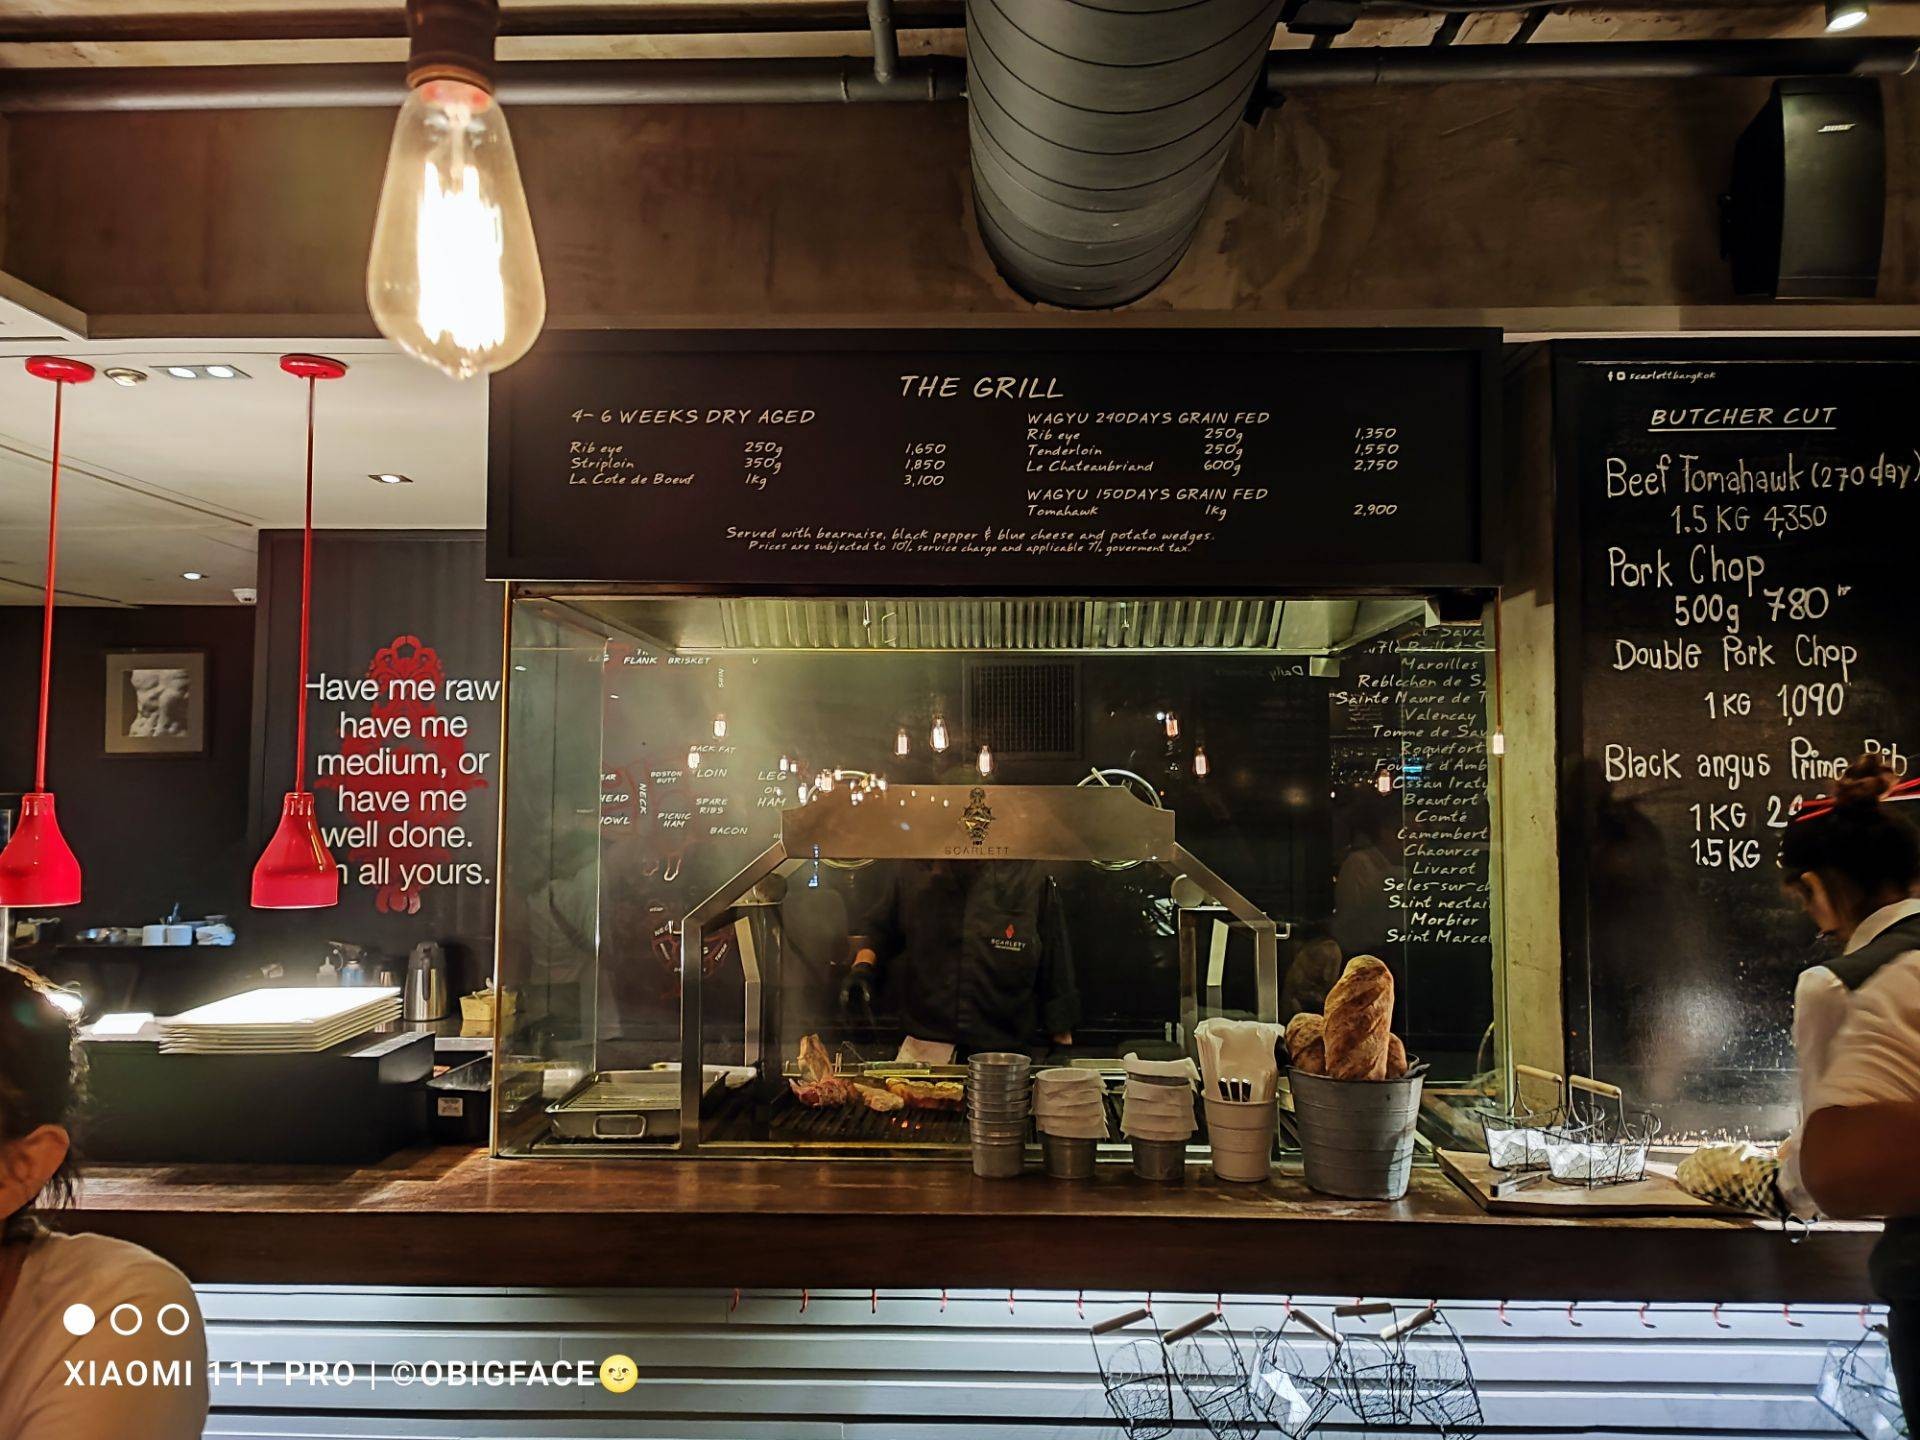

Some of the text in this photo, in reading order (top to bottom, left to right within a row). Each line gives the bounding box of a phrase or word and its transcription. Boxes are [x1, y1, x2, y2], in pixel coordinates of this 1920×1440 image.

[900, 375, 1064, 399] THE GRILL
[620, 408, 699, 424] WEEKS
[706, 408, 752, 424] DRY
[758, 408, 816, 424] AGED
[1027, 412, 1270, 425] WAGYU 240DAYS GRAIN FED
[1651, 407, 1838, 427] BUTCHER CUT
[1026, 427, 1397, 445] Rib eye 250g 1,350
[570, 441, 947, 459] Rib eye 250g 1,650
[1028, 443, 1400, 461] Tenderloin 250g 1,550
[570, 457, 946, 475] Striploin 350g 1,850
[1026, 459, 1399, 477] Le Chateaubriand 600g 2,750
[569, 473, 587, 485] La
[592, 472, 625, 485] Cote
[631, 473, 648, 485] de
[653, 472, 695, 485] Boeuf
[903, 474, 945, 487] 3,100
[1605, 453, 1672, 499] Beef
[1679, 452, 1805, 496] Tomahawk
[1027, 488, 1269, 501] WAGYU 150DAYS GRAIN FED
[1028, 504, 1099, 517] Tomahawk
[1353, 503, 1398, 516] 2,900
[1670, 503, 1828, 541] 1.5 KG 4,350
[725, 526, 1216, 546] Served with bearnaise, black pepper & blue cheese and potato wedges.
[749, 540, 786, 551] Prices
[790, 543, 810, 551] are
[815, 541, 869, 553] subjected
[873, 541, 886, 551] to
[917, 542, 957, 553] service
[961, 542, 998, 556] charge
[1001, 543, 1023, 552] and
[1026, 542, 1084, 555] applicable
[1607, 543, 1766, 598] Pork Chop
[1675, 585, 1830, 634] 500g 780
[623, 656, 713, 665] FLANK BRISKET
[1401, 657, 1478, 670] Maroilles
[1613, 633, 1858, 684] Double Pork Chop
[1442, 674, 1462, 687] de
[389, 678, 436, 701] me
[445, 678, 501, 701] raw
[1335, 690, 1471, 705] Sainte Maure de
[1776, 681, 1845, 727] 1,090
[1405, 707, 1477, 727] Valencay
[339, 711, 468, 739] have me
[1372, 724, 1450, 738] Tomme de
[1401, 741, 1486, 758] Roquefort
[317, 747, 490, 779] medium, or
[1604, 736, 1849, 791] Black angus Prime
[650, 770, 683, 778] BOSTON
[696, 768, 728, 779] LOIN
[757, 770, 787, 781] LEG
[338, 785, 467, 813] have me
[638, 782, 648, 816] NECK
[696, 797, 729, 806] SPARE
[757, 797, 787, 807] HAM
[1404, 792, 1479, 806] Beaufort
[657, 812, 692, 820] PICNIC
[699, 806, 724, 815] RIBS
[663, 820, 686, 829] HAM
[709, 826, 749, 835] BACON
[321, 820, 473, 848] well done.
[1397, 826, 1488, 840] Camembert
[944, 846, 1009, 856] SCARLETT
[1404, 843, 1480, 857] Chaource
[358, 857, 390, 885] all
[400, 862, 490, 892] yours.
[1412, 861, 1477, 875] Livarot
[1388, 894, 1490, 909] Saint nectai
[1410, 912, 1480, 926] Morbier
[1386, 928, 1430, 943] Saint
